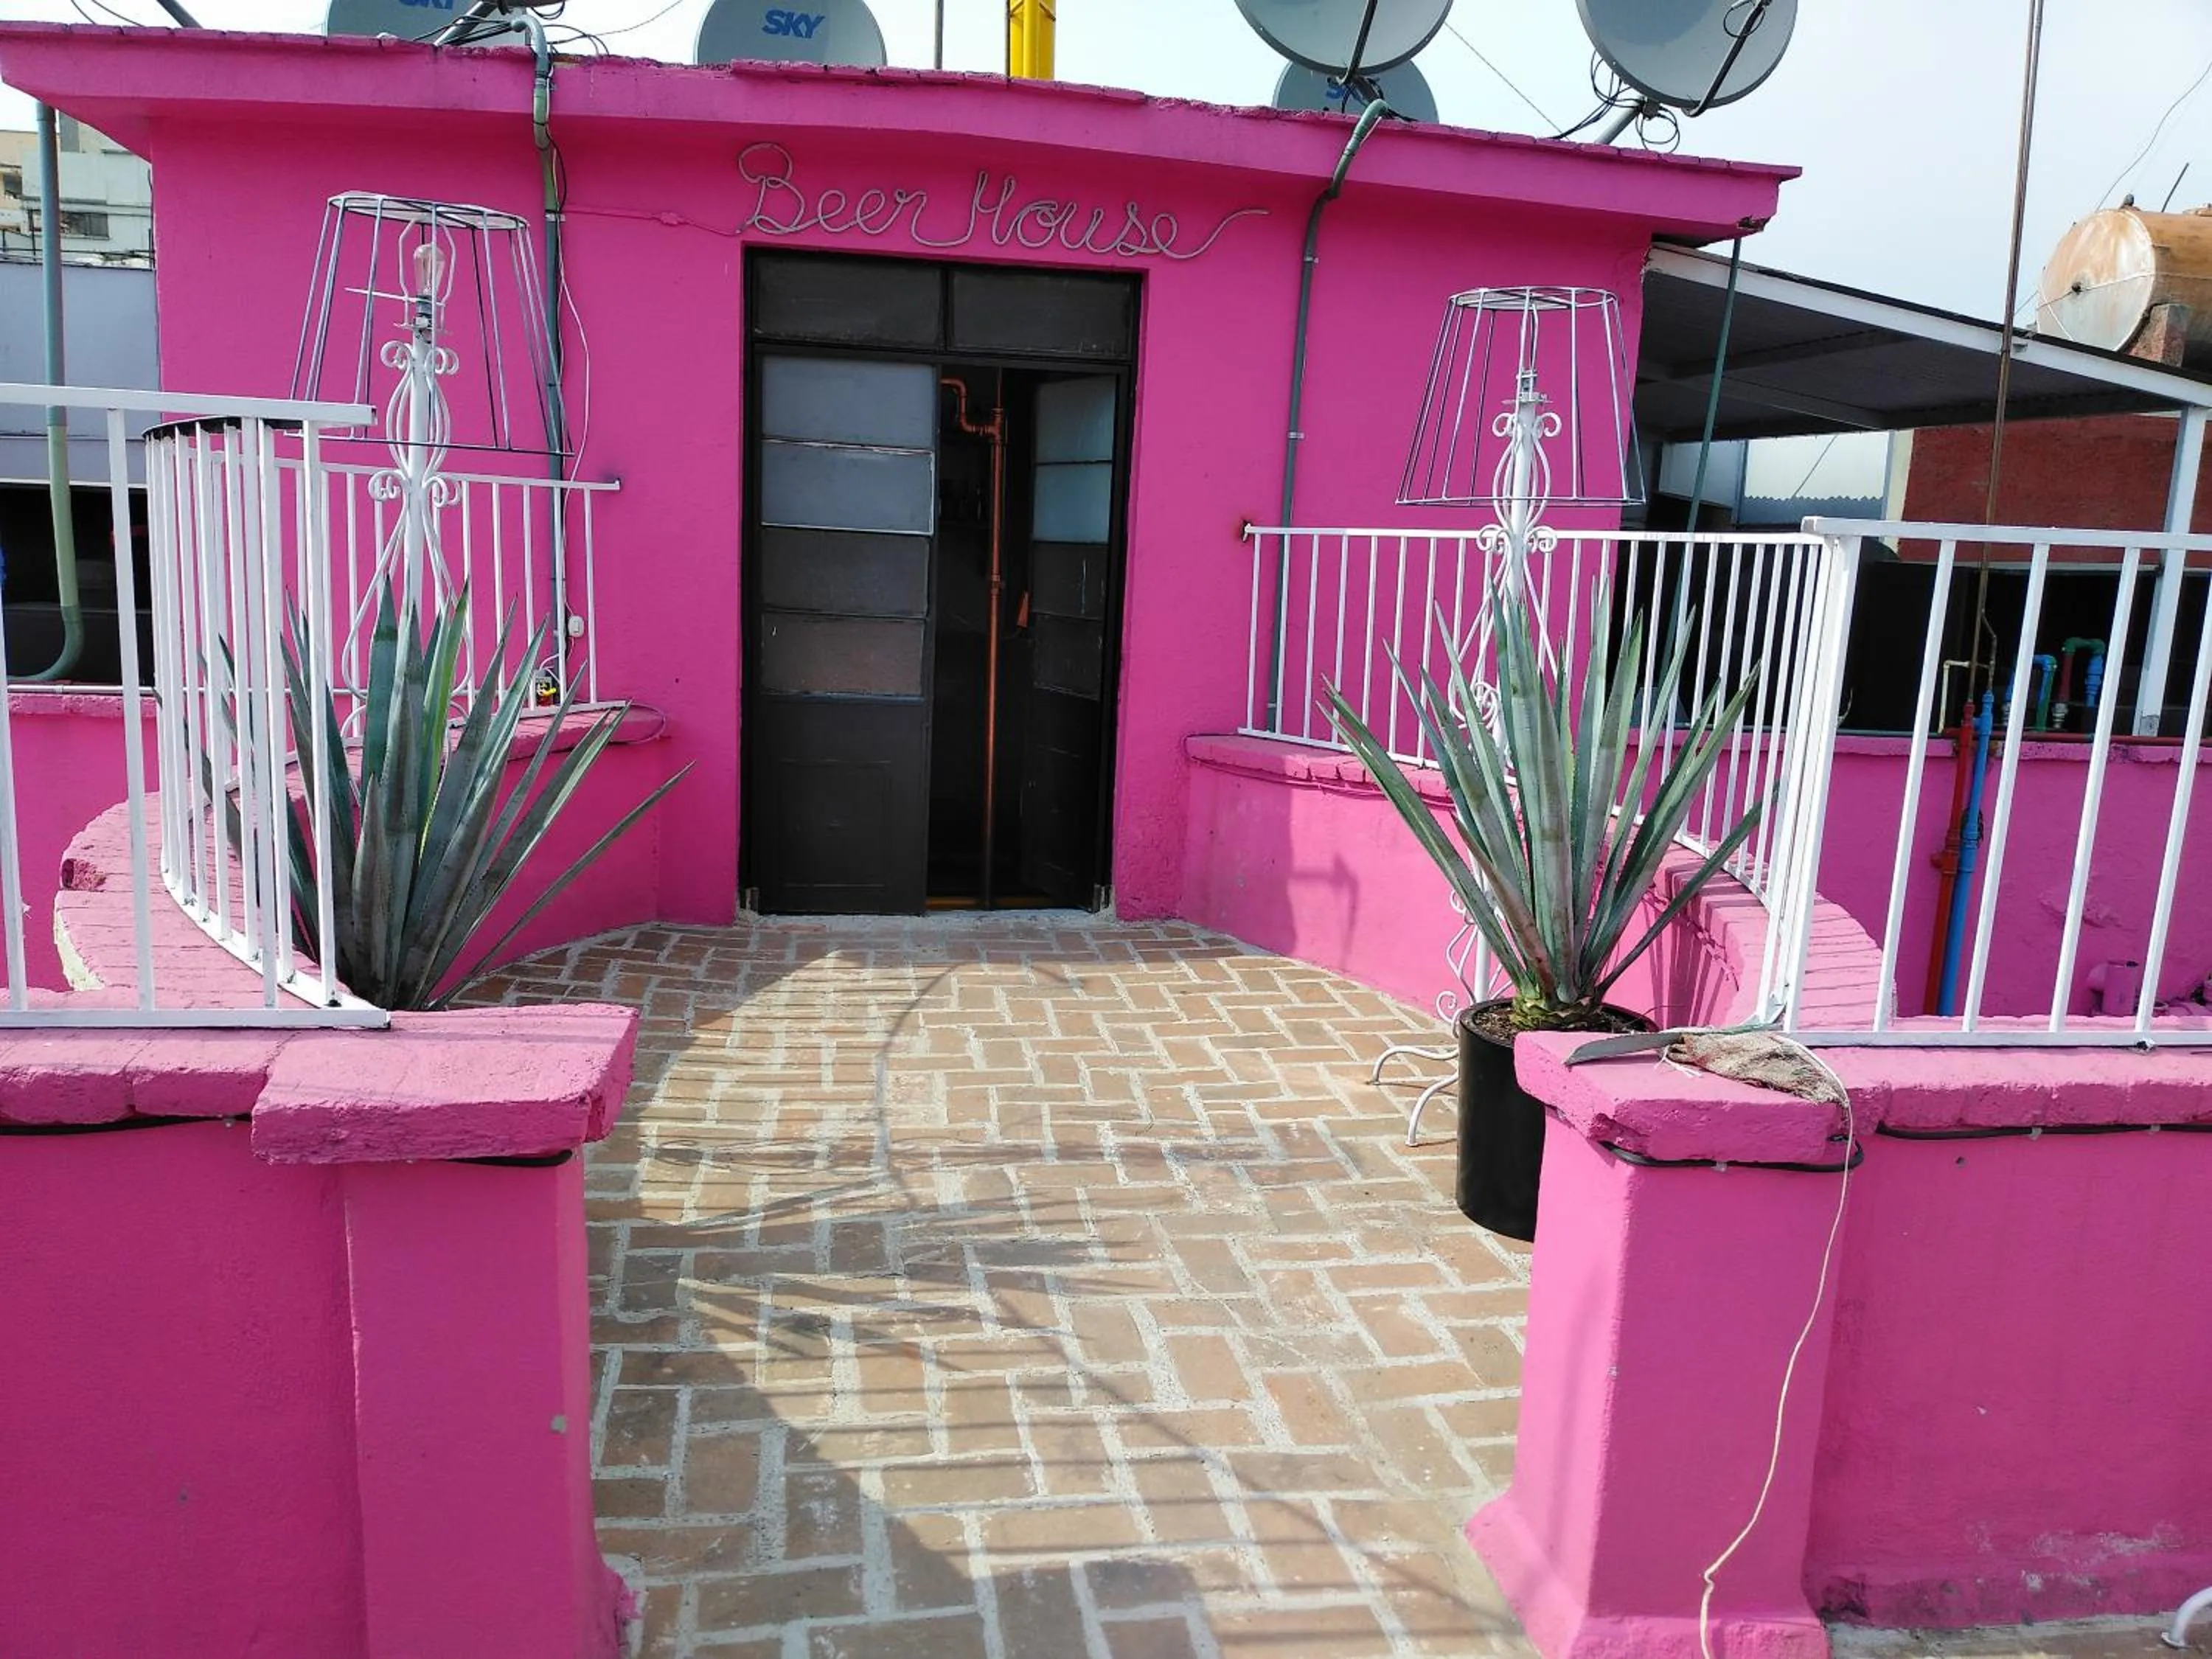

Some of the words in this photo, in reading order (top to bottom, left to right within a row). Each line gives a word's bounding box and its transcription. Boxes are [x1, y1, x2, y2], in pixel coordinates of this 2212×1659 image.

[762, 10, 825, 38] SKY
[739, 144, 928, 244] Beer
[961, 170, 1267, 259] House
